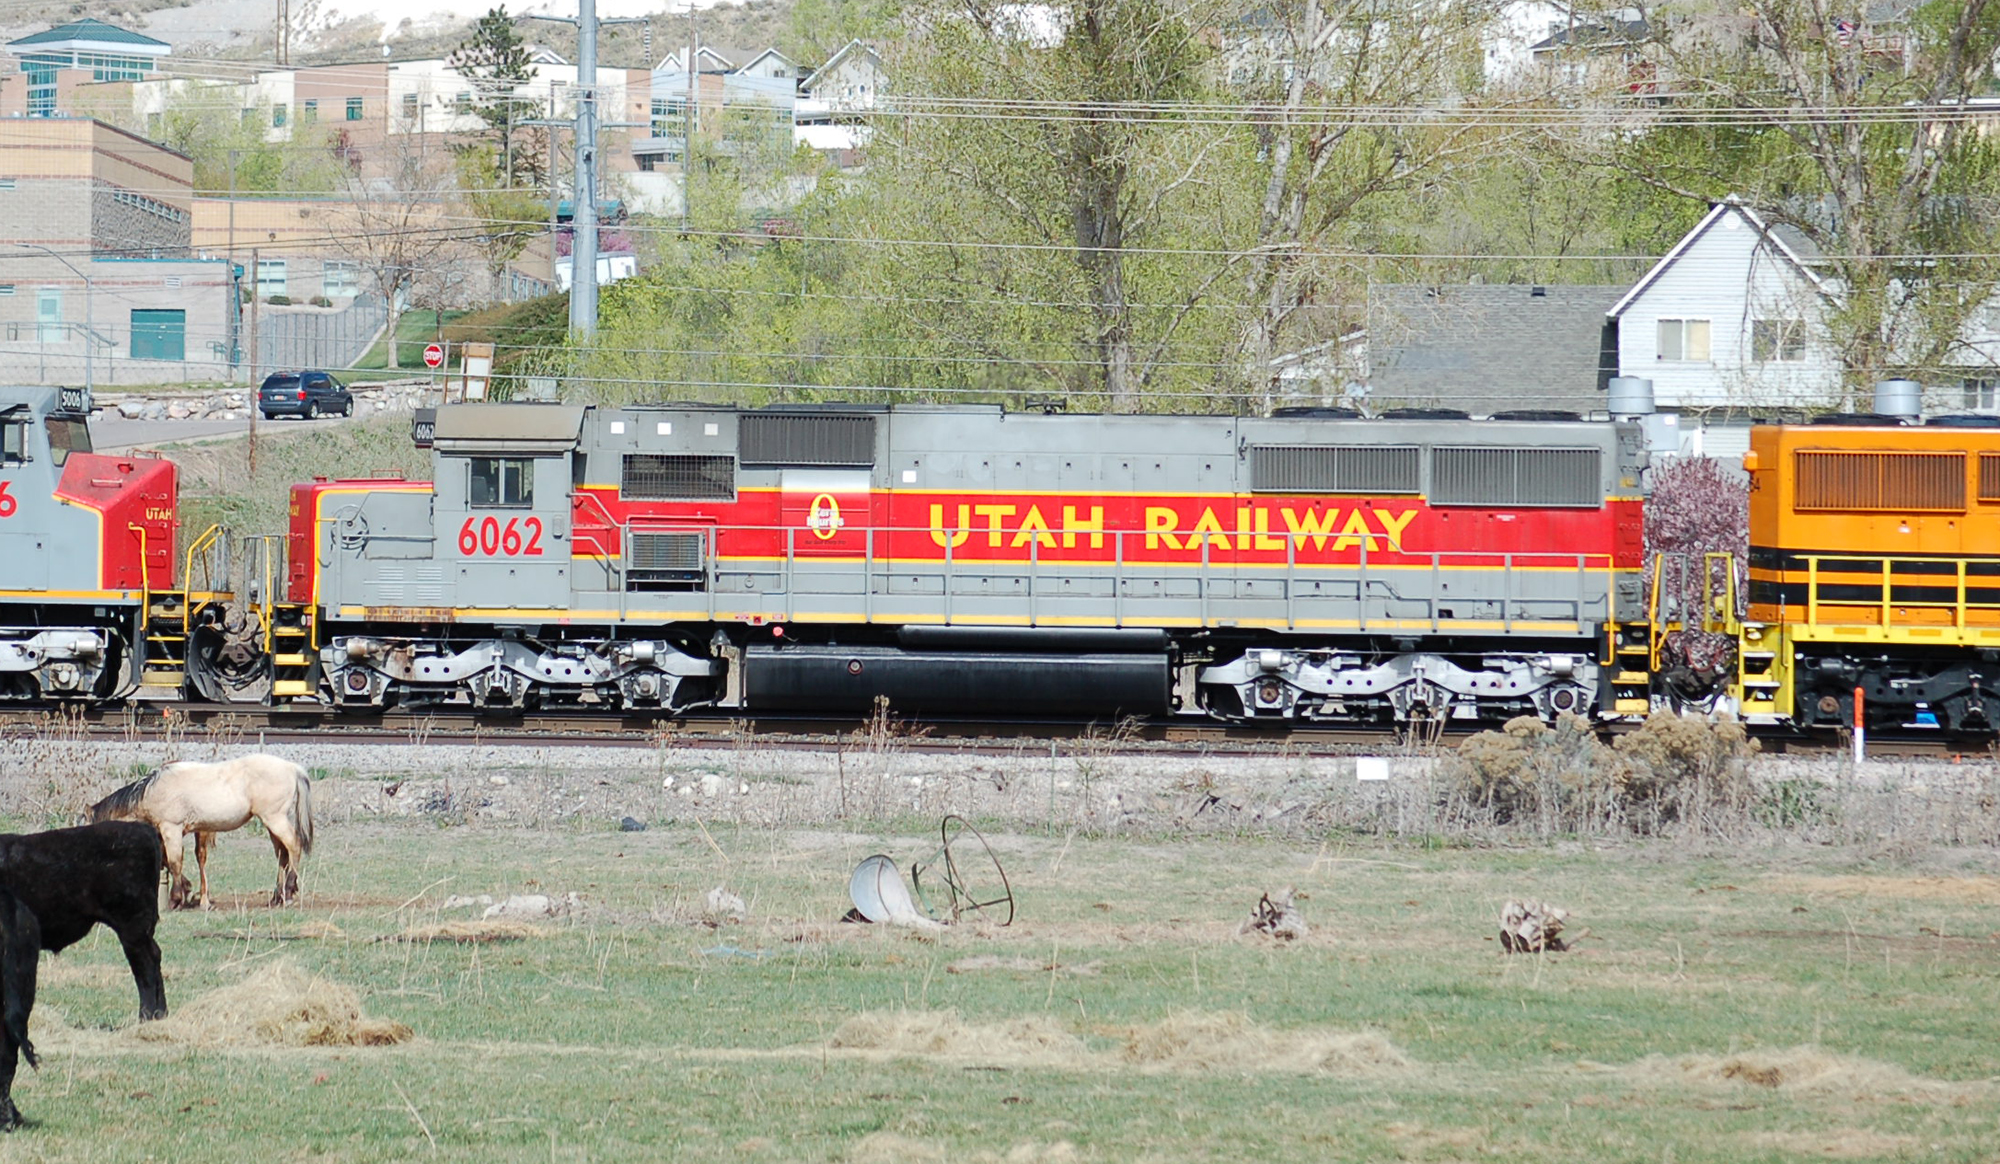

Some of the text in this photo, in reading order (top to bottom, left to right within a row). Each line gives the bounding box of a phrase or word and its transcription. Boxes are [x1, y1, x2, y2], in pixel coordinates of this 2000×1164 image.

[425, 351, 441, 361] STOP
[416, 423, 434, 440] 6062
[146, 508, 173, 521] UTAH
[458, 516, 544, 557] 6062
[929, 503, 1419, 553] UTAH RAILWAY
